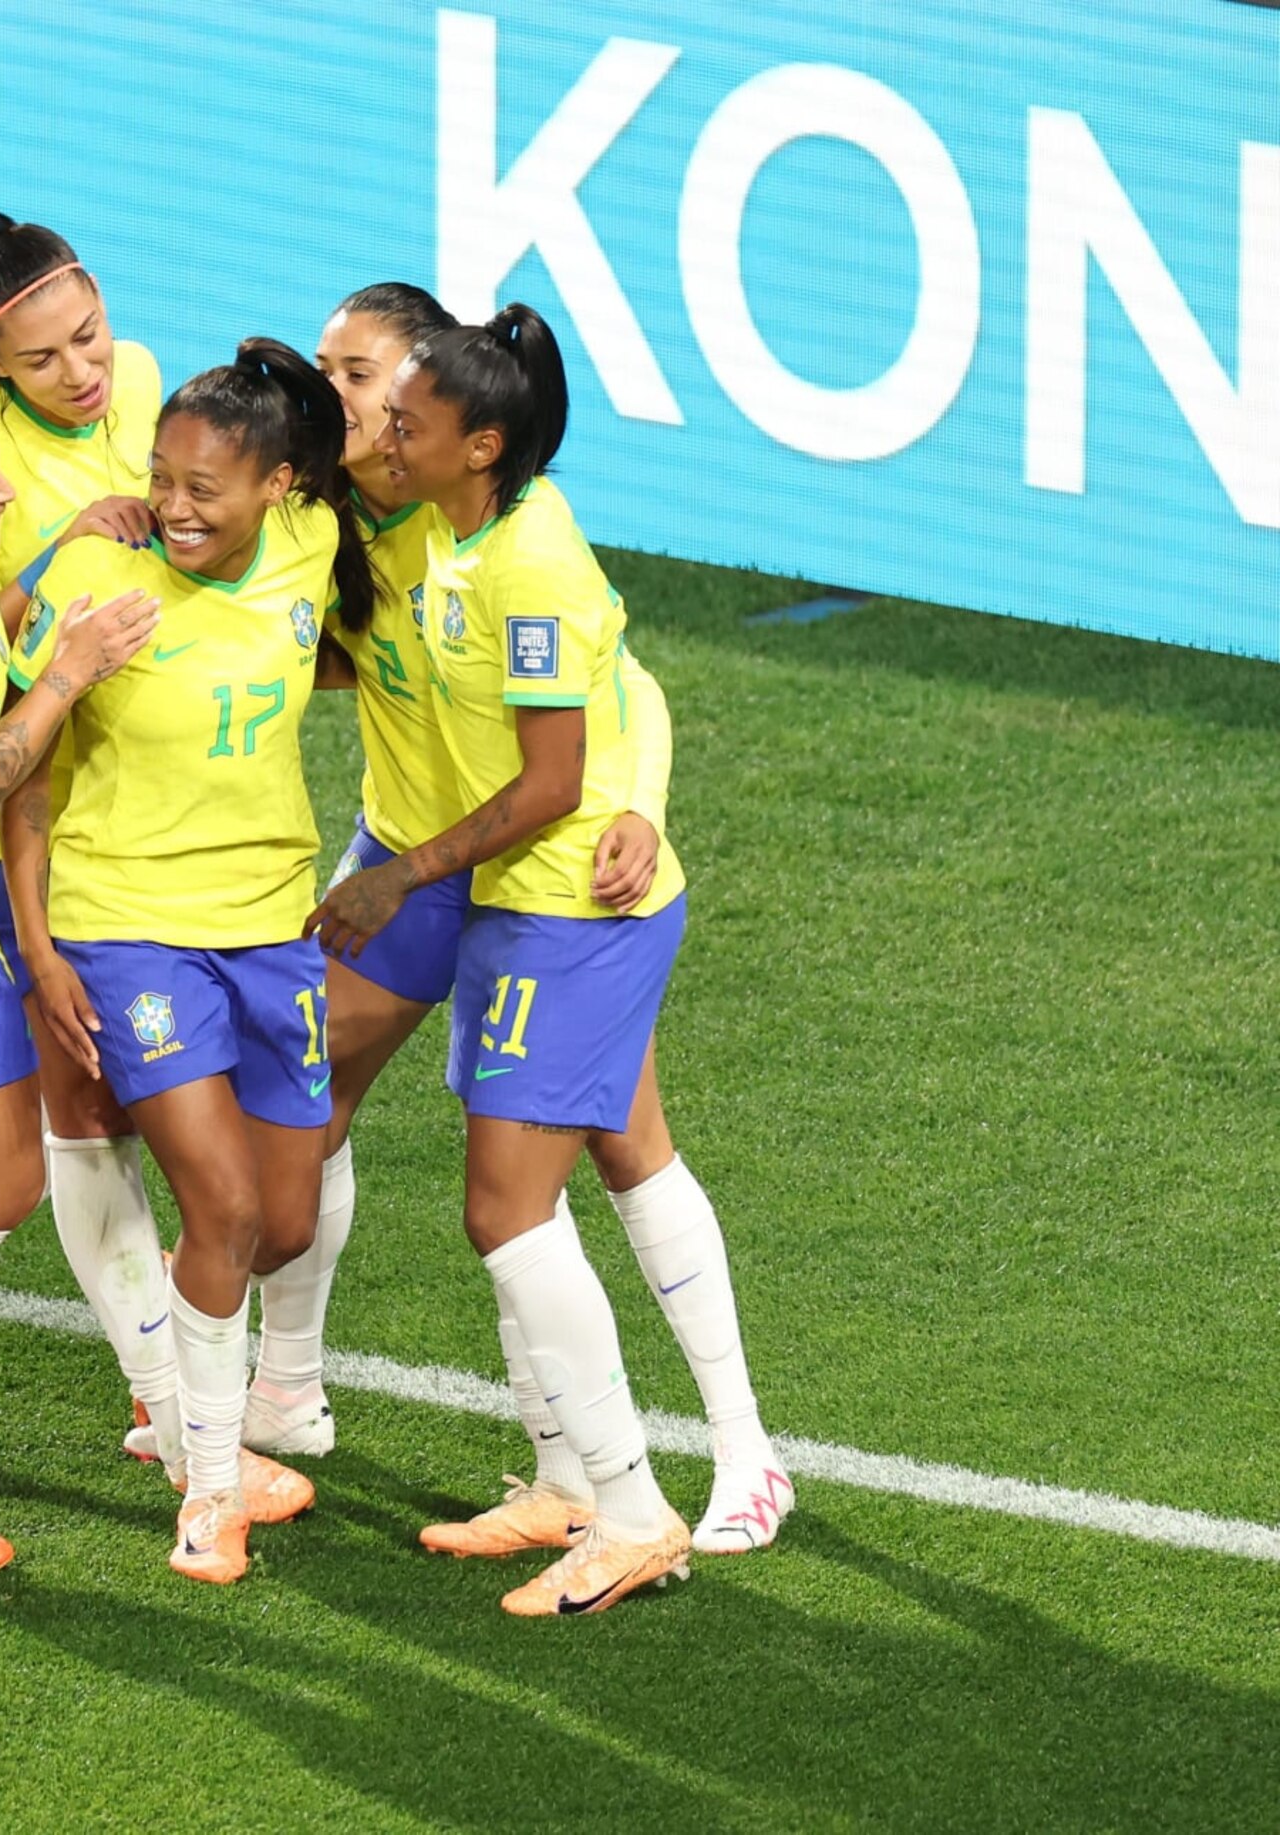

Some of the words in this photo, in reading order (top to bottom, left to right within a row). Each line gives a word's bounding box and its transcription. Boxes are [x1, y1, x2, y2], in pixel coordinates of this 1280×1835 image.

[368, 631, 417, 702] 2
[207, 676, 284, 759] 17
[142, 1040, 185, 1063] BRASIL
[295, 977, 327, 1068] 1
